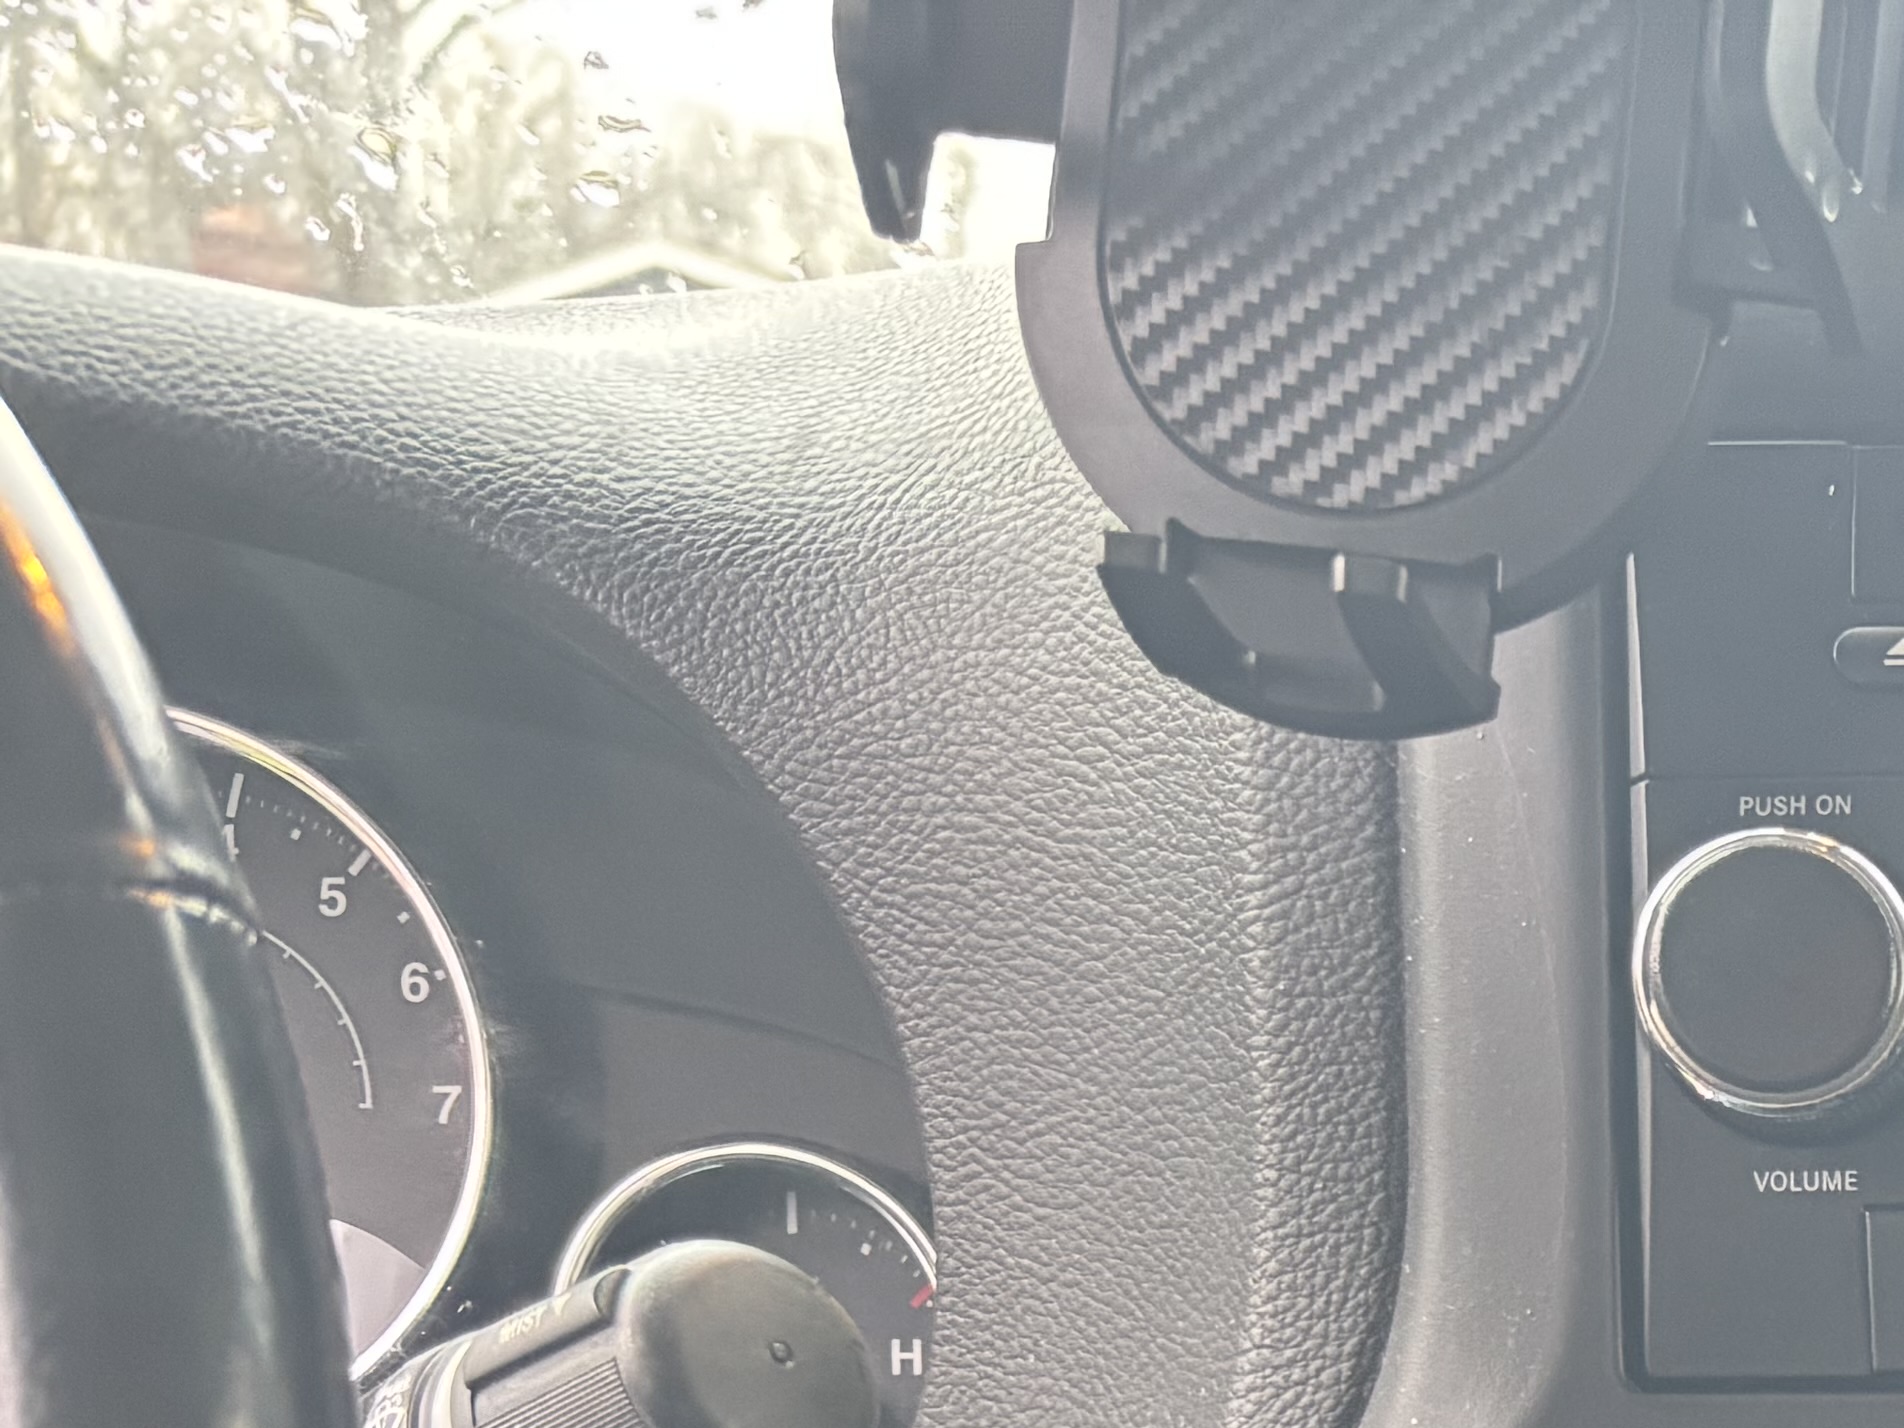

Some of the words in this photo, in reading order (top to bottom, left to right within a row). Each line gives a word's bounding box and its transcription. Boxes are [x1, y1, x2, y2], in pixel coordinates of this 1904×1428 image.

[1739, 794, 1806, 817] PUSH
[1815, 794, 1852, 816] ON
[319, 876, 347, 917] 5
[400, 961, 430, 1003] 6
[431, 1085, 462, 1125] 7
[1753, 1170, 1858, 1193] VOLUME
[890, 1338, 924, 1376] H
